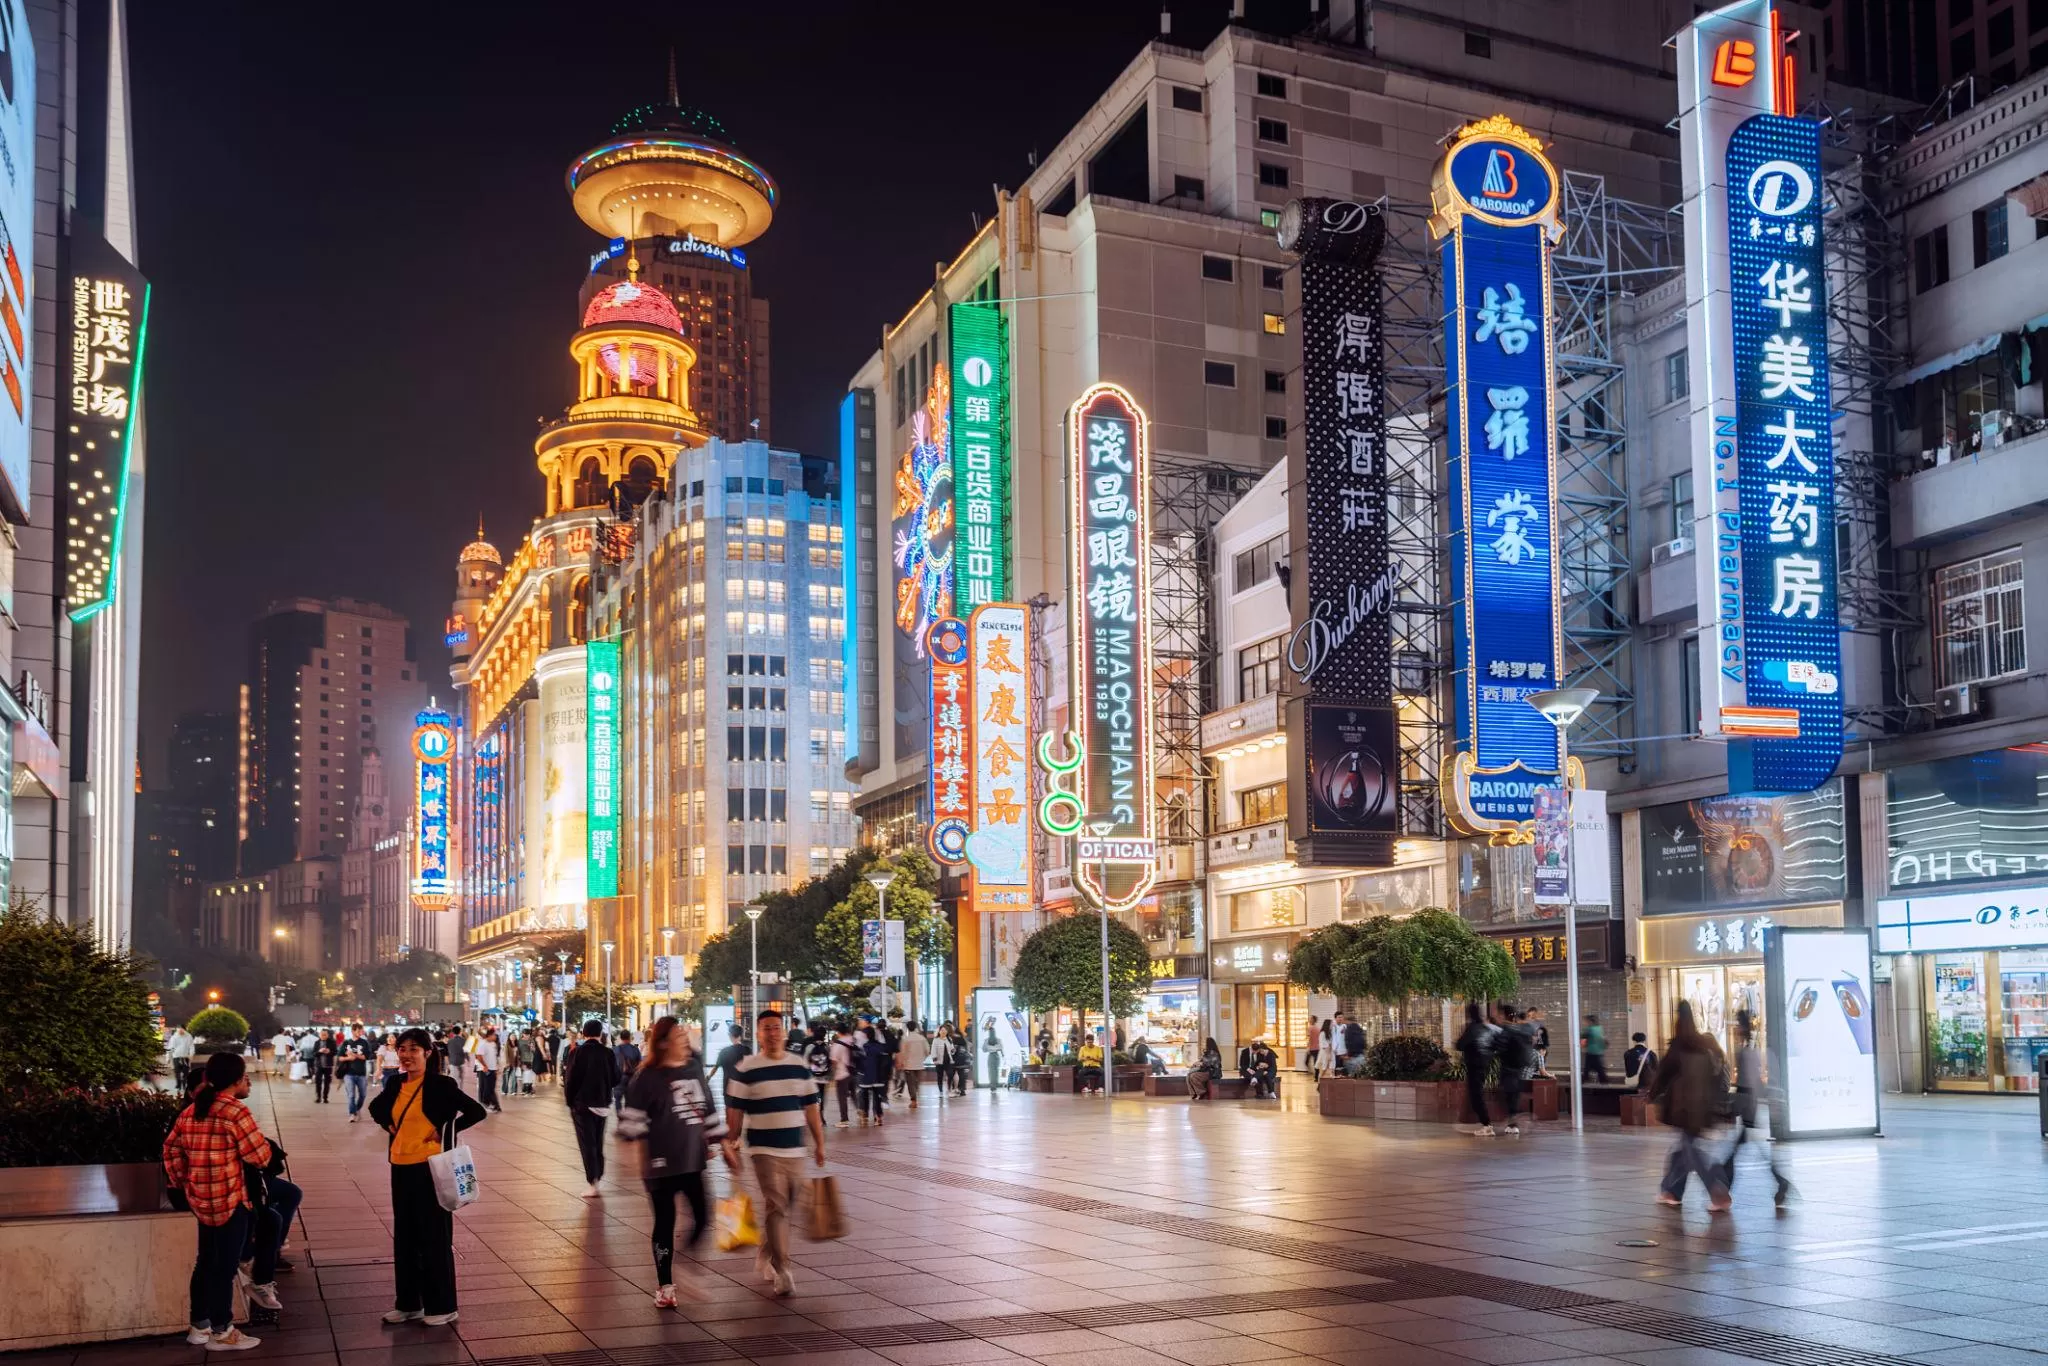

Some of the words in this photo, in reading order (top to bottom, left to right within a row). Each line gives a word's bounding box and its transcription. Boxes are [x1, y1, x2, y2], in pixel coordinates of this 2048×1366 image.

[1470, 196, 1530, 215] BAROMON
[73, 276, 90, 329] SHIMAO
[72, 330, 90, 384] FESTIVAL
[90, 280, 131, 419] 世茂广场
[72, 386, 89, 415] CITY
[1715, 415, 1739, 492] No.1
[1758, 260, 1824, 619] 华美大药房
[965, 396, 993, 604] 第一百货商业中心
[1087, 421, 1137, 622] 茂昌眼镜
[1288, 560, 1403, 684] Duchamp
[1717, 512, 1745, 684] Pharmacy
[1095, 628, 1107, 675] SINCE
[980, 633, 1024, 825] 泰康食品
[1096, 683, 1108, 721] 1923
[1109, 628, 1134, 825] MAOCHANG
[422, 772, 446, 874] 新世界城
[1475, 802, 1516, 813] MENS
[1576, 822, 1605, 831] ROLEX
[1080, 842, 1154, 858] OPTICAL
[2008, 904, 2048, 921] 第一
